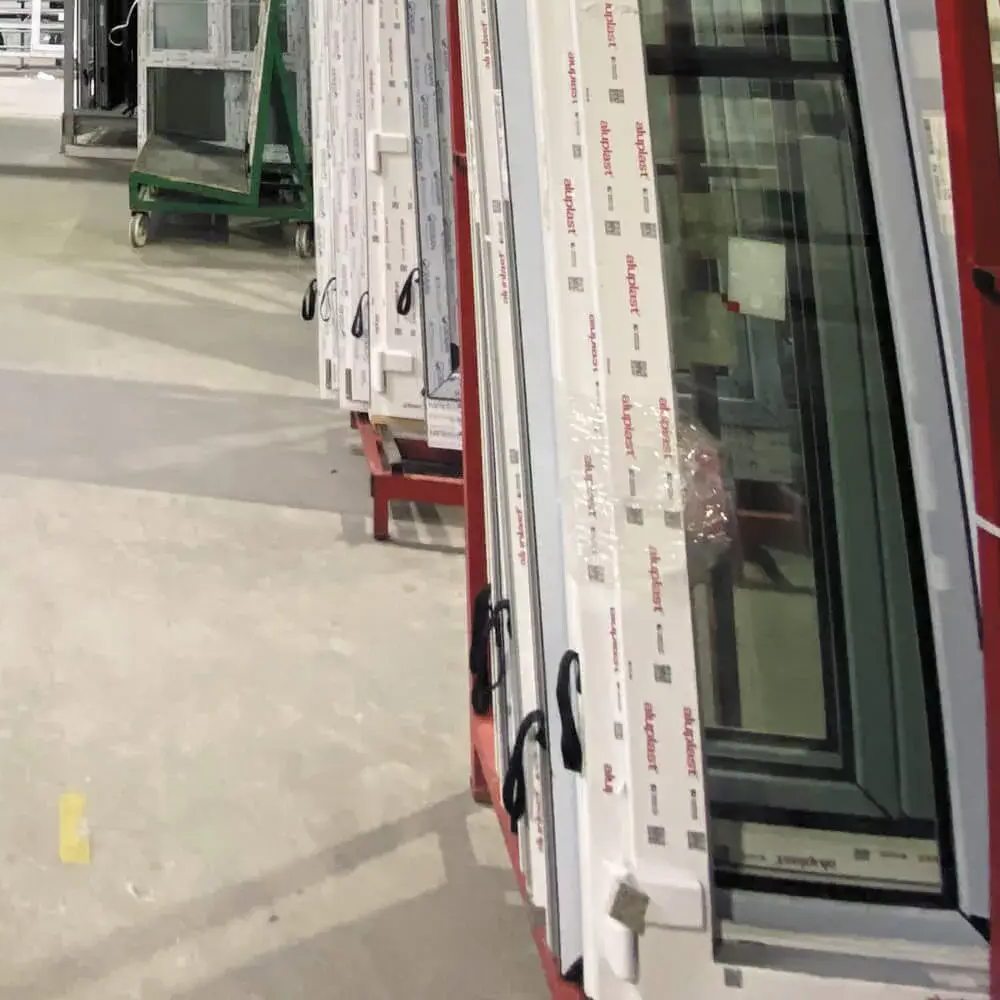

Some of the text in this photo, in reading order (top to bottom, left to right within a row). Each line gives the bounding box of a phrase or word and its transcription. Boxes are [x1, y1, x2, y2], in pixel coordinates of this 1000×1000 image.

[600, 120, 614, 177] aluplast
[635, 121, 650, 178] aluplast
[563, 178, 577, 236] aluplast
[626, 254, 641, 316] aluplast
[643, 702, 658, 773] aluplast
[683, 706, 698, 778] aluplast
